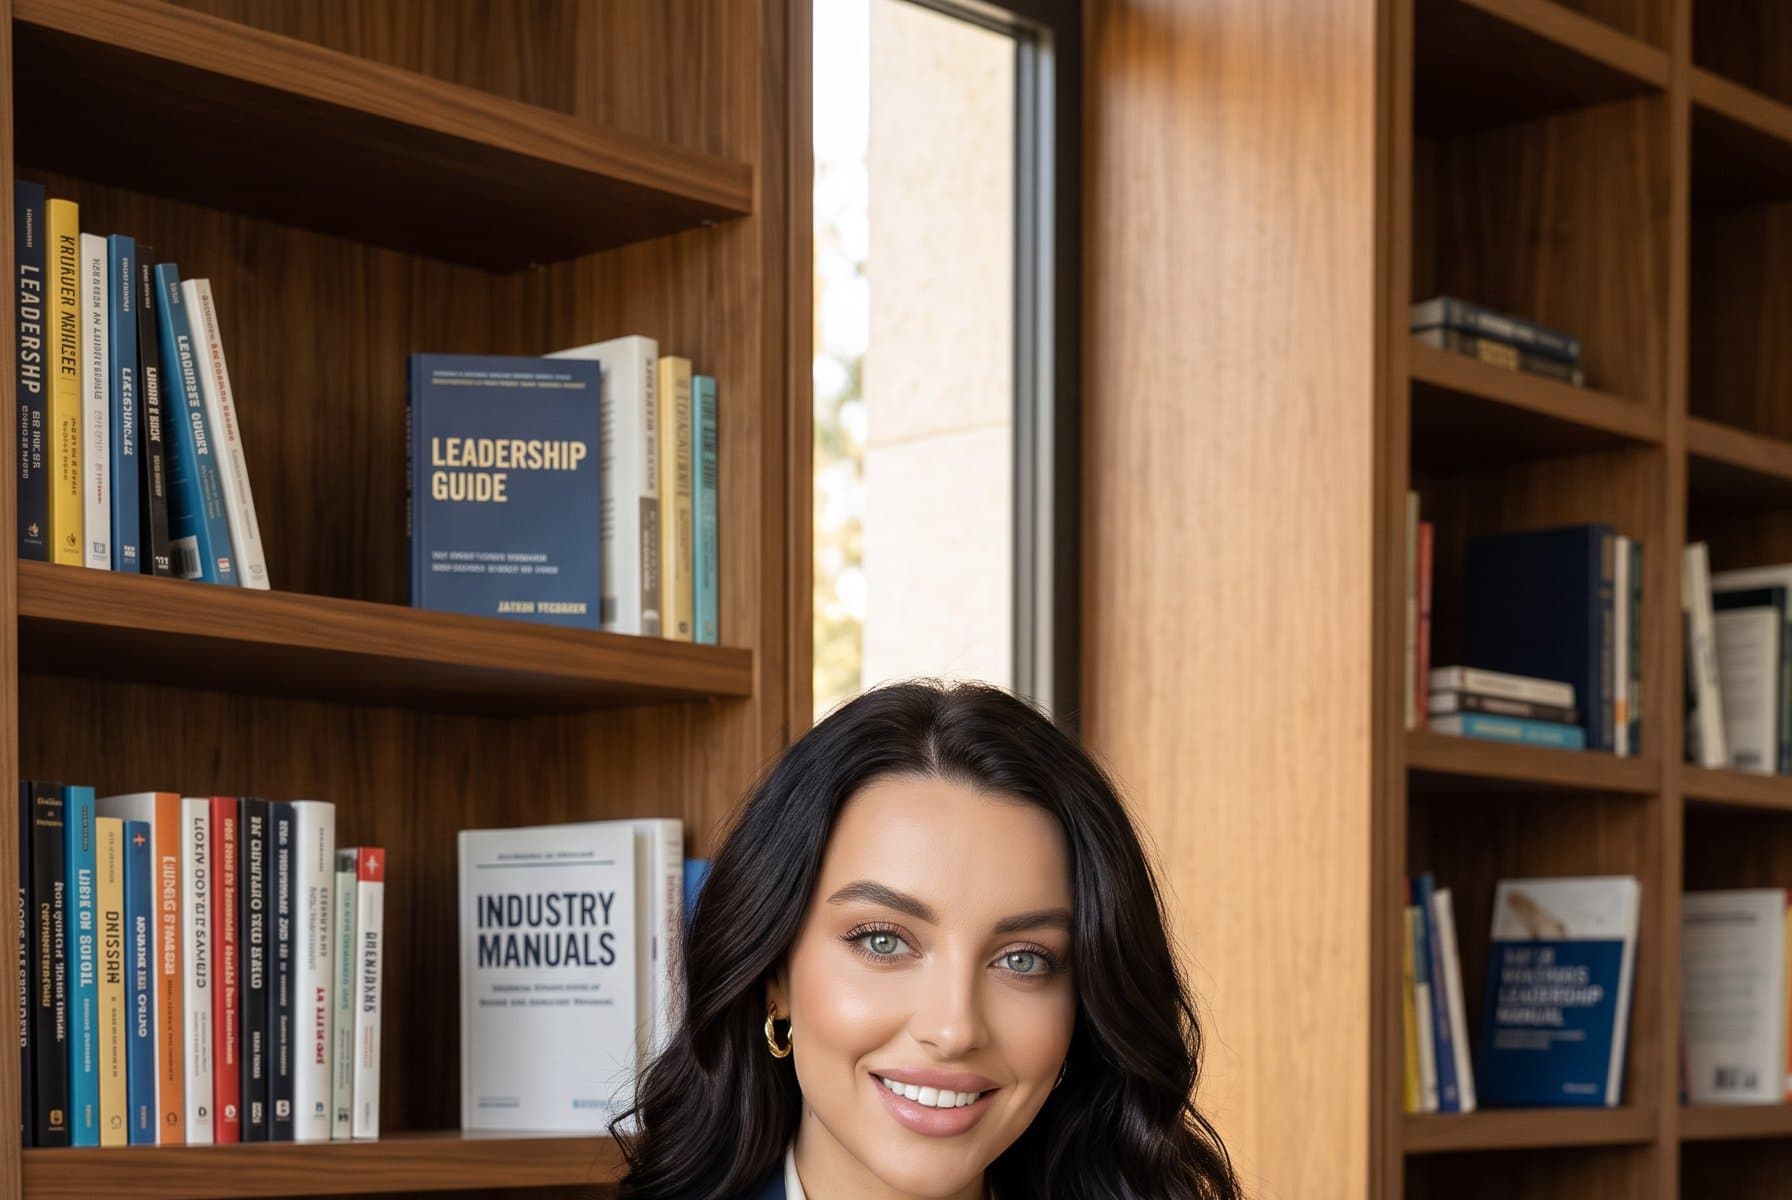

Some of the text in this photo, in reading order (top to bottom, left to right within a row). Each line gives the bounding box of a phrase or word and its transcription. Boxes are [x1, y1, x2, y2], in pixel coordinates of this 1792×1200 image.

[432, 437, 587, 470] LEADERSHIP
[432, 472, 508, 502] GUIDE
[478, 892, 615, 929] INDUSTRY
[478, 933, 615, 968] MANUALS
